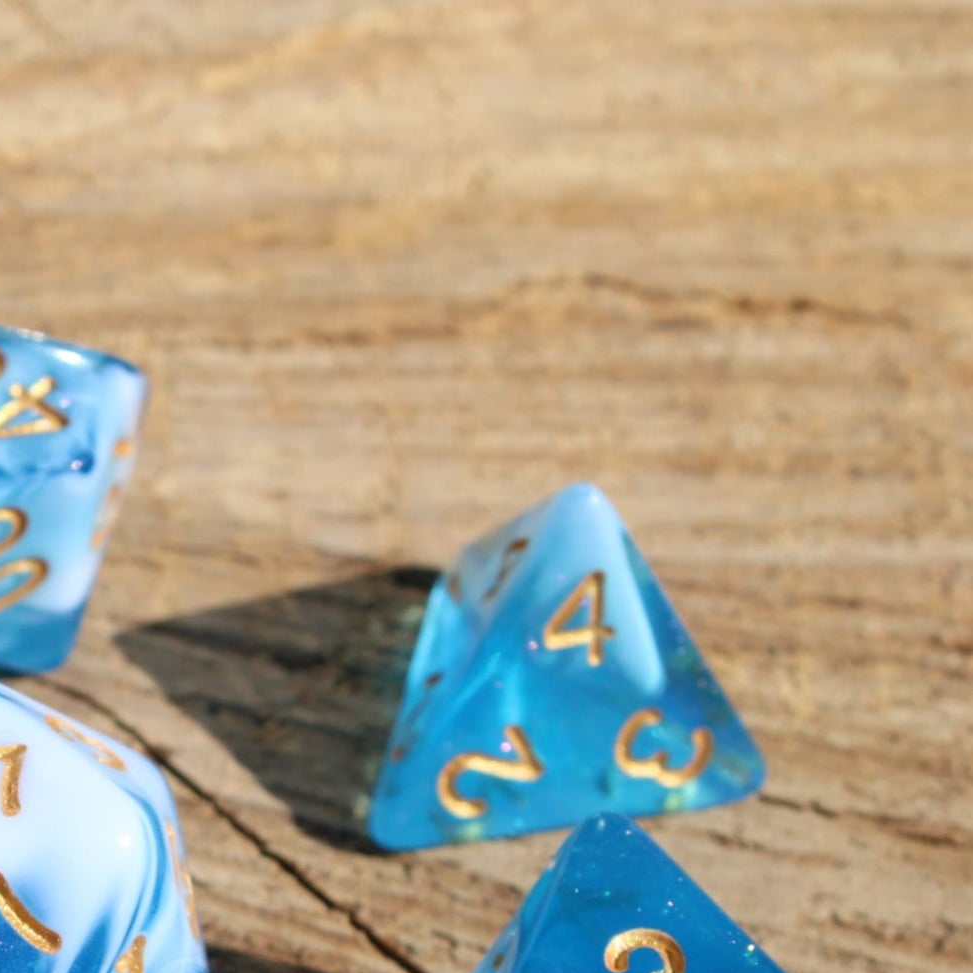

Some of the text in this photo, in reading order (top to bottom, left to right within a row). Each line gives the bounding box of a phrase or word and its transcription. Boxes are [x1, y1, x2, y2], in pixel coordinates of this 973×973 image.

[543, 571, 615, 668] 4
[436, 724, 545, 819] 2
[614, 707, 715, 789] 3
